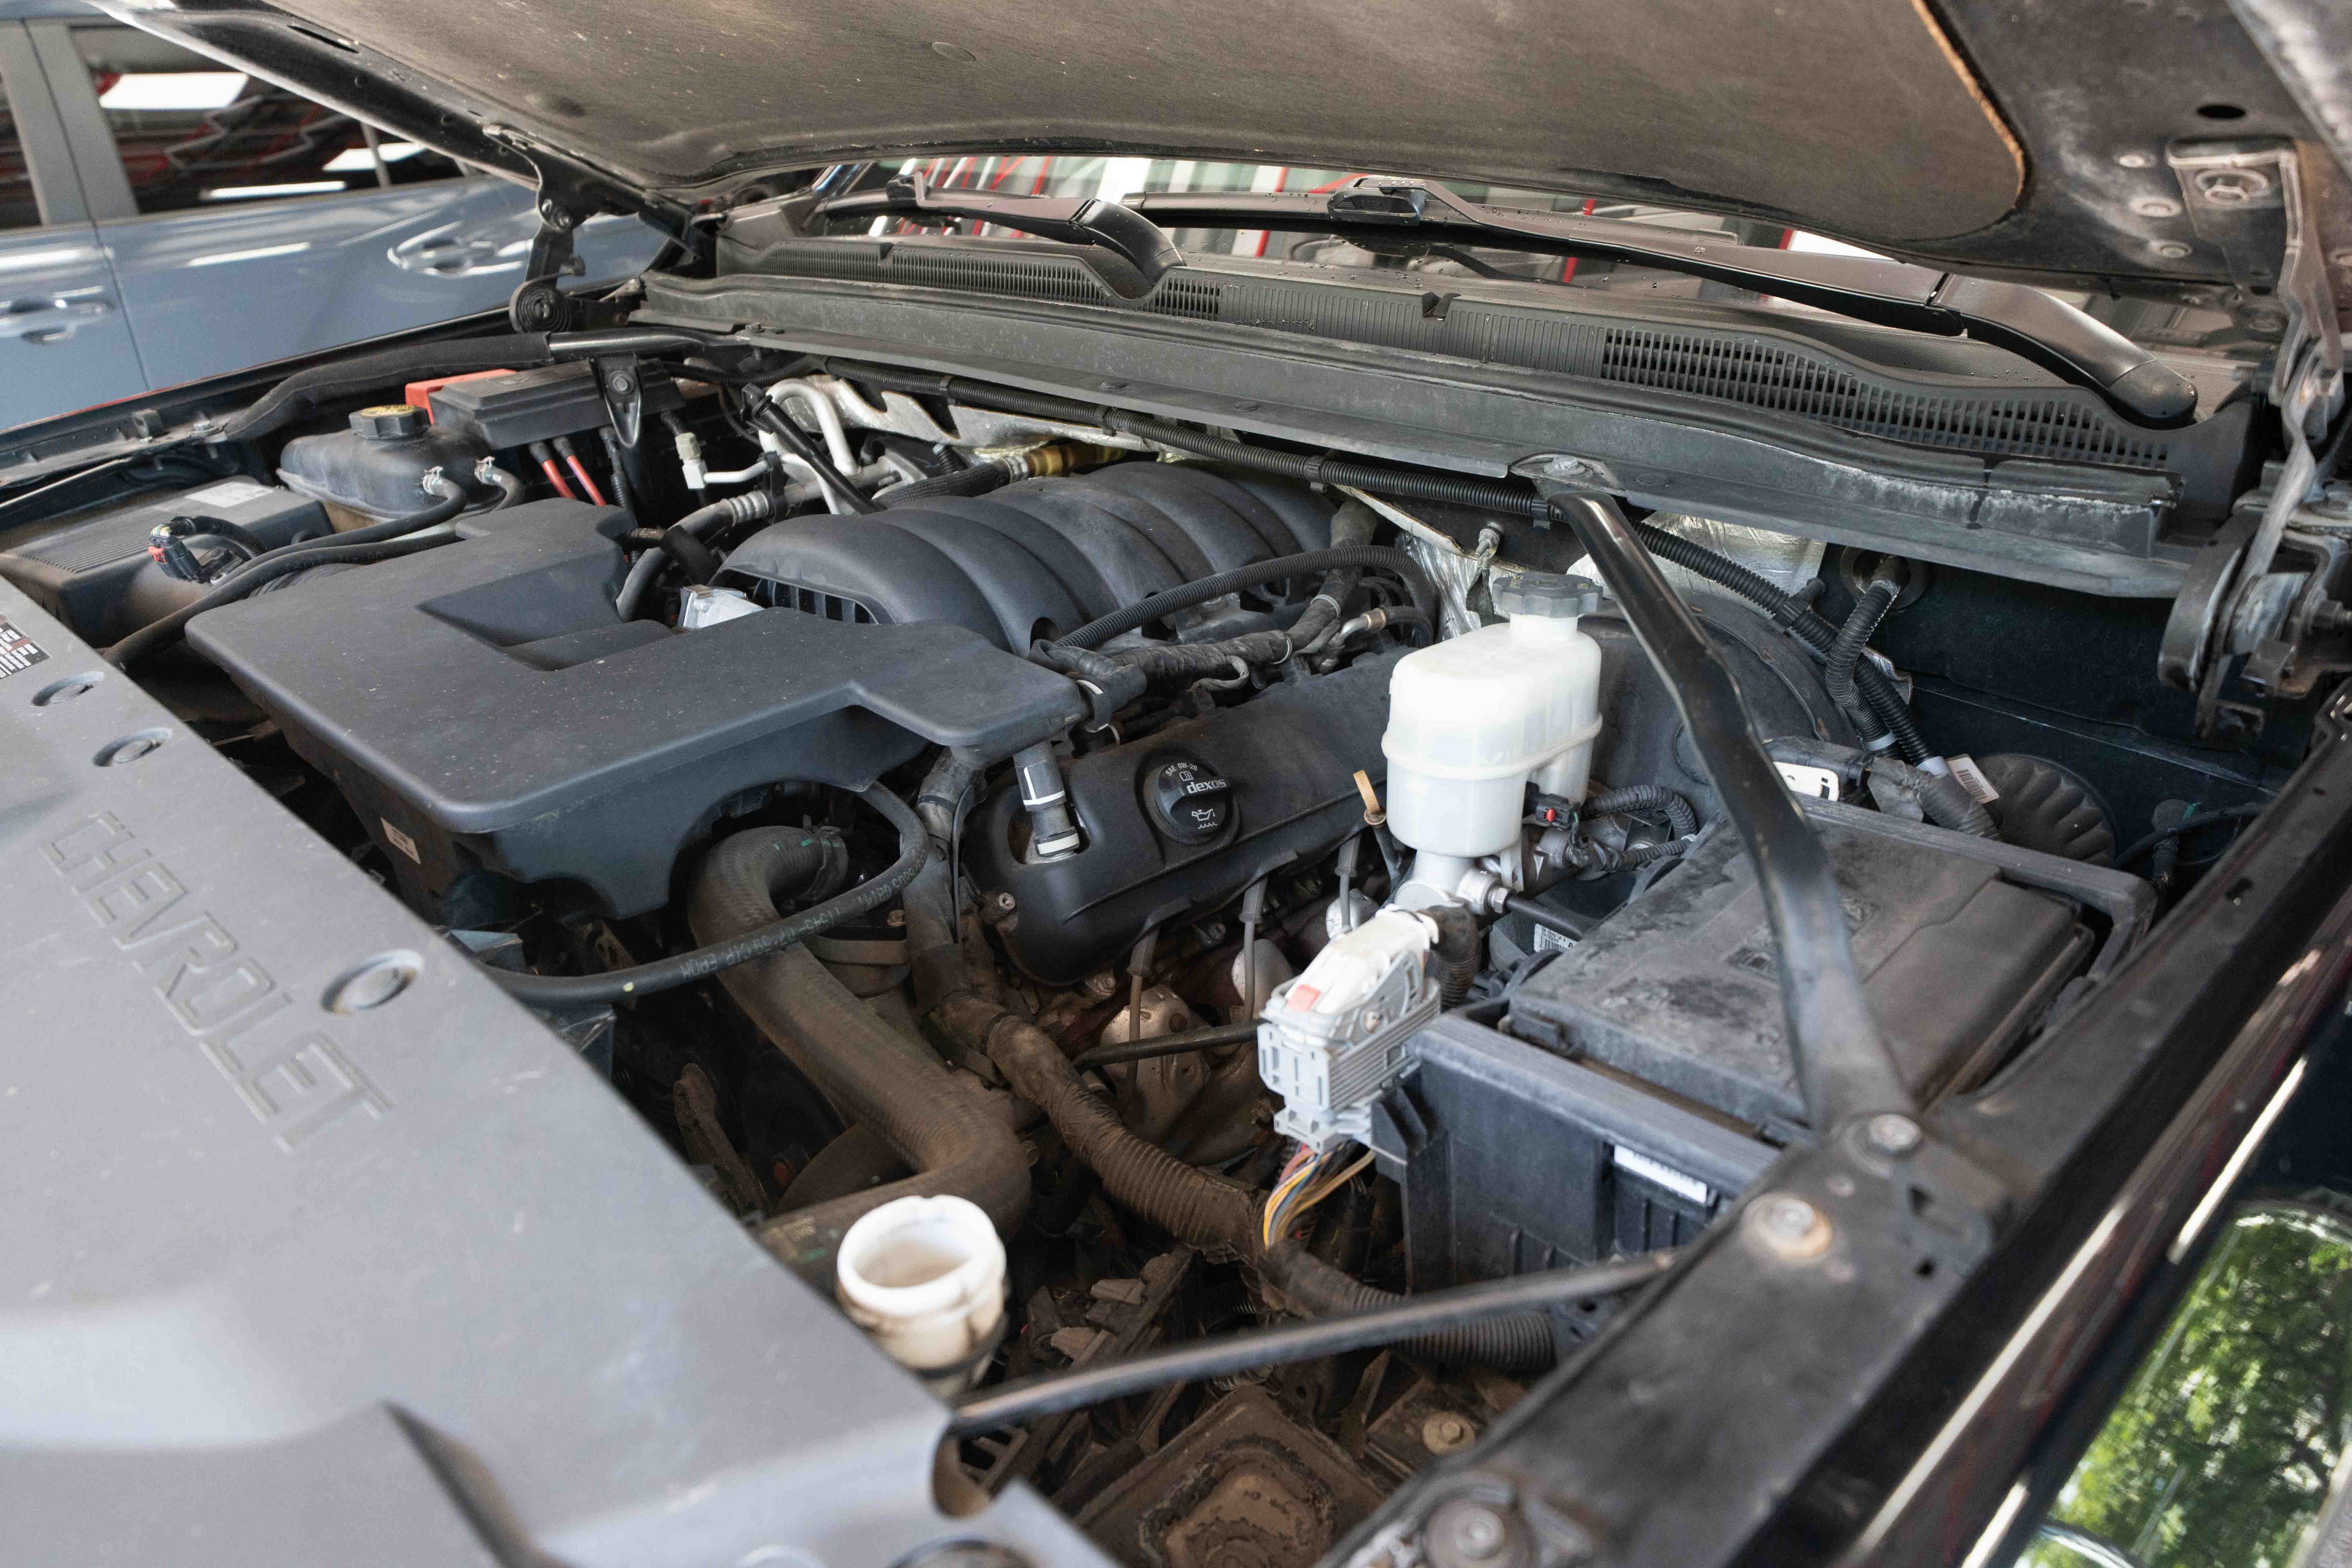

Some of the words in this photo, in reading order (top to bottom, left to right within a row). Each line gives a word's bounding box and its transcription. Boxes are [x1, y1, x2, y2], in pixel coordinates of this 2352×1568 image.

[1165, 765, 1177, 776] SAE
[1177, 762, 1197, 771] 0W-20
[1186, 779, 1227, 793] dexos
[39, 810, 394, 1152] CHEVROLET
